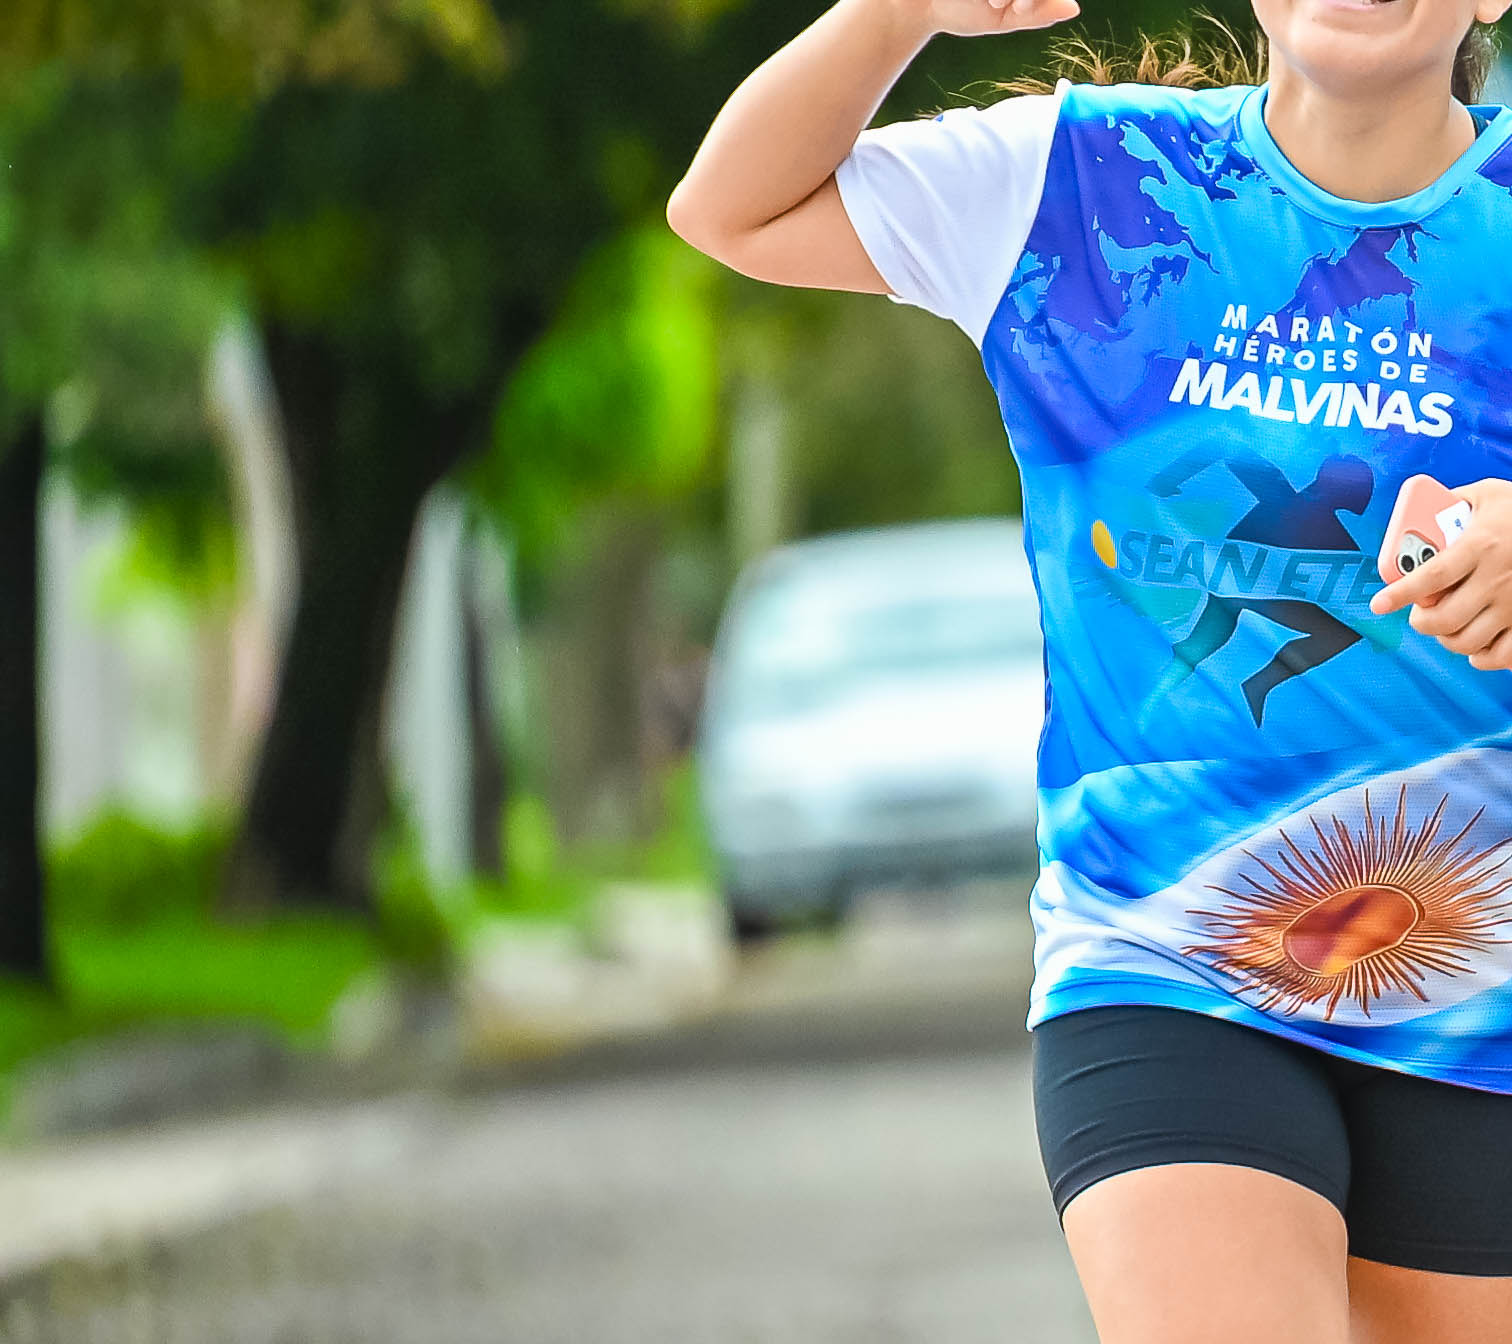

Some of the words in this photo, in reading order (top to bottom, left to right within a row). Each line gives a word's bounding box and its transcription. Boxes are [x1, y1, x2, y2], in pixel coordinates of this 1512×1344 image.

[1213, 333, 1359, 372] HÉROES
[1379, 360, 1428, 384] DE
[1221, 303, 1433, 358] MARATÓN
[1168, 357, 1455, 438] MALVINAS
[1119, 529, 1270, 594] SEAN
[1277, 551, 1379, 605] ETE
